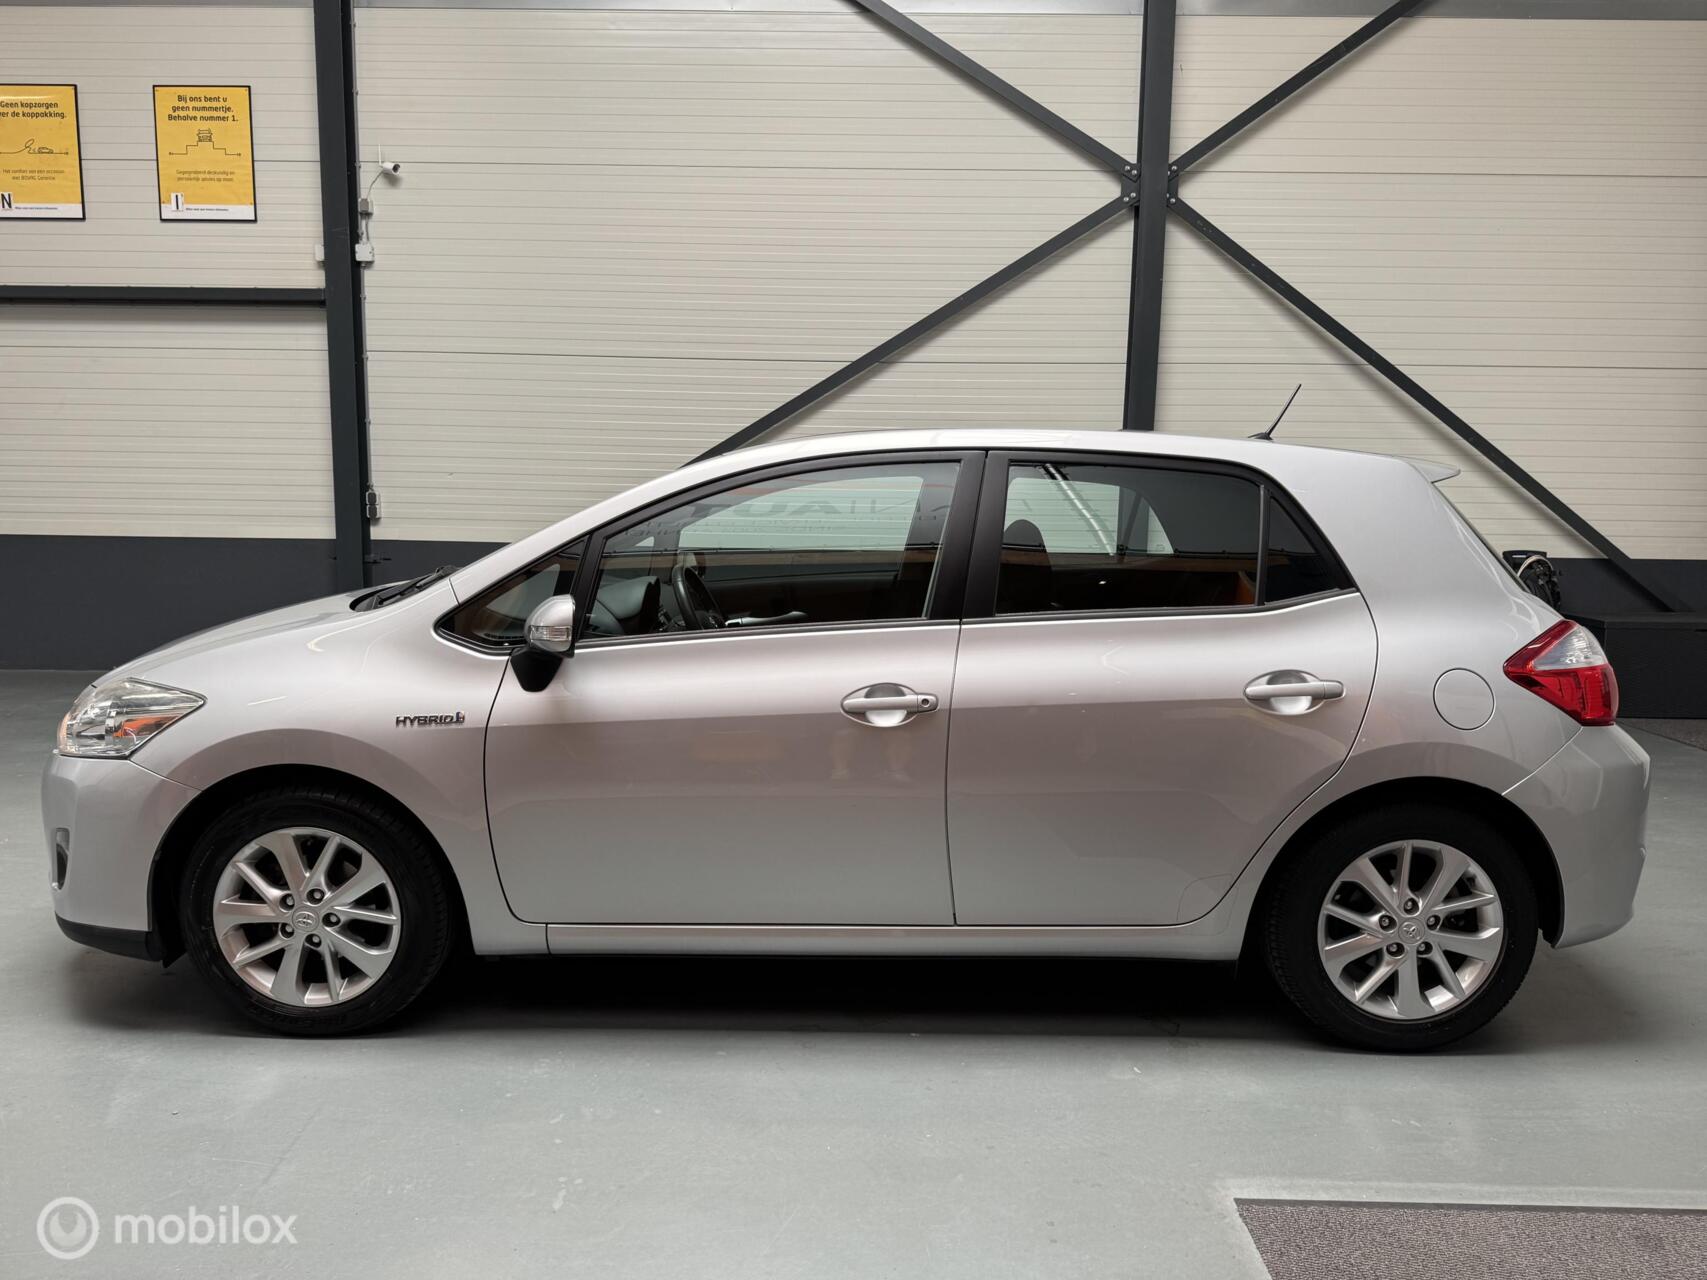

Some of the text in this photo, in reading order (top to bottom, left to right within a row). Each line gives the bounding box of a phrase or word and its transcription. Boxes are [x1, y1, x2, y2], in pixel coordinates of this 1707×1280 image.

[177, 95, 187, 103] Bij
[20, 101, 58, 109] kopzorgen
[22, 111, 67, 119] koppakking.
[395, 714, 454, 727] HYBRID
